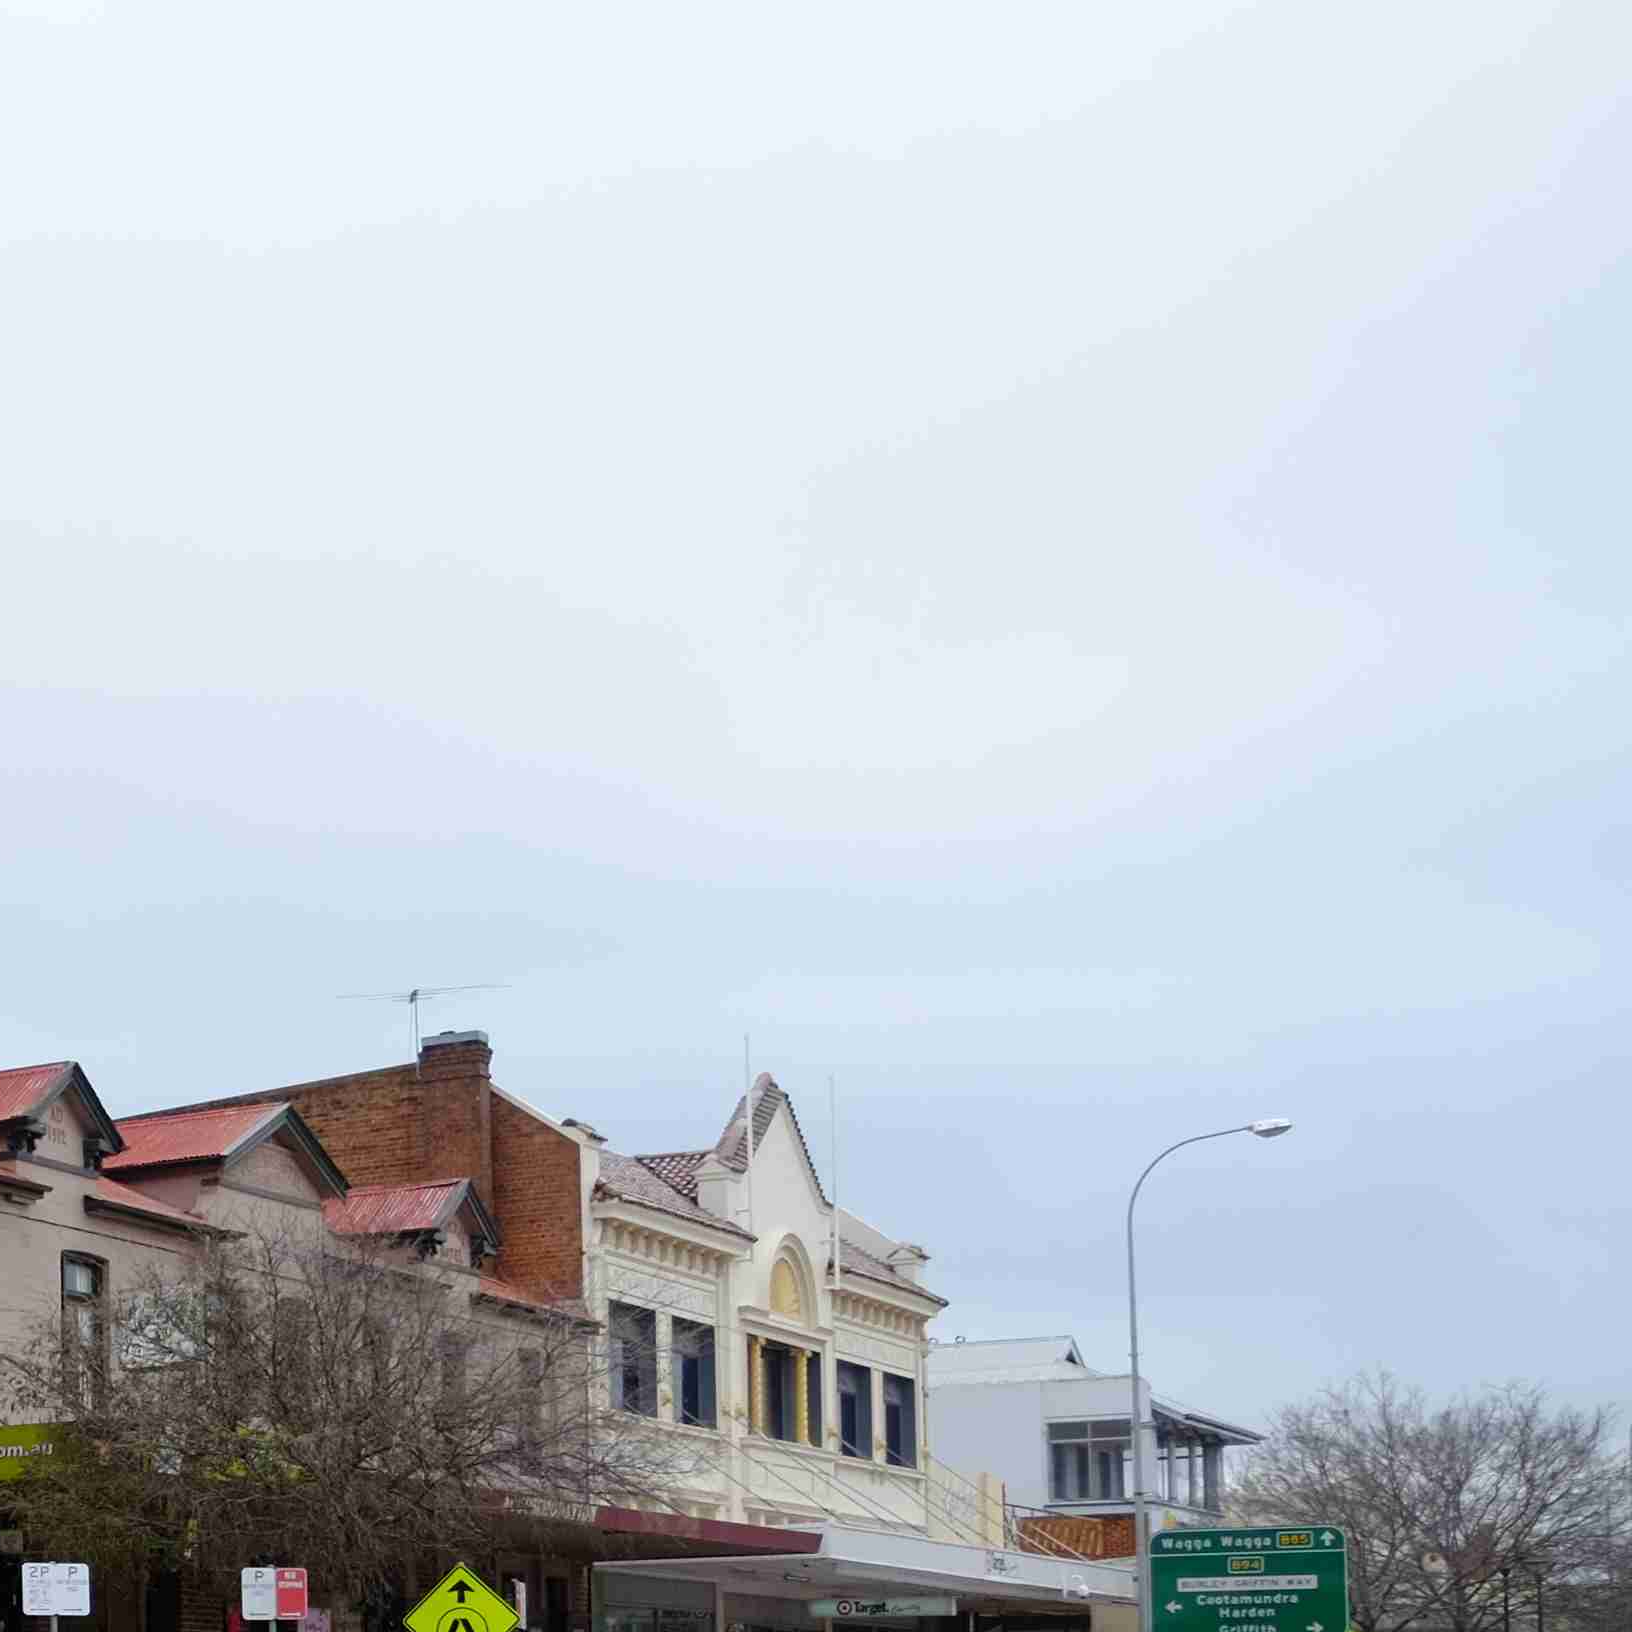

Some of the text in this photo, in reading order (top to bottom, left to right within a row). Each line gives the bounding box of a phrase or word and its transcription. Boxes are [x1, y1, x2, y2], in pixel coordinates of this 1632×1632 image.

[1161, 1537, 1212, 1551] Wagga
[1220, 1535, 1272, 1549] Wagga
[1196, 1594, 1299, 1606] Cootamundra
[1219, 1607, 1275, 1618] Harden
